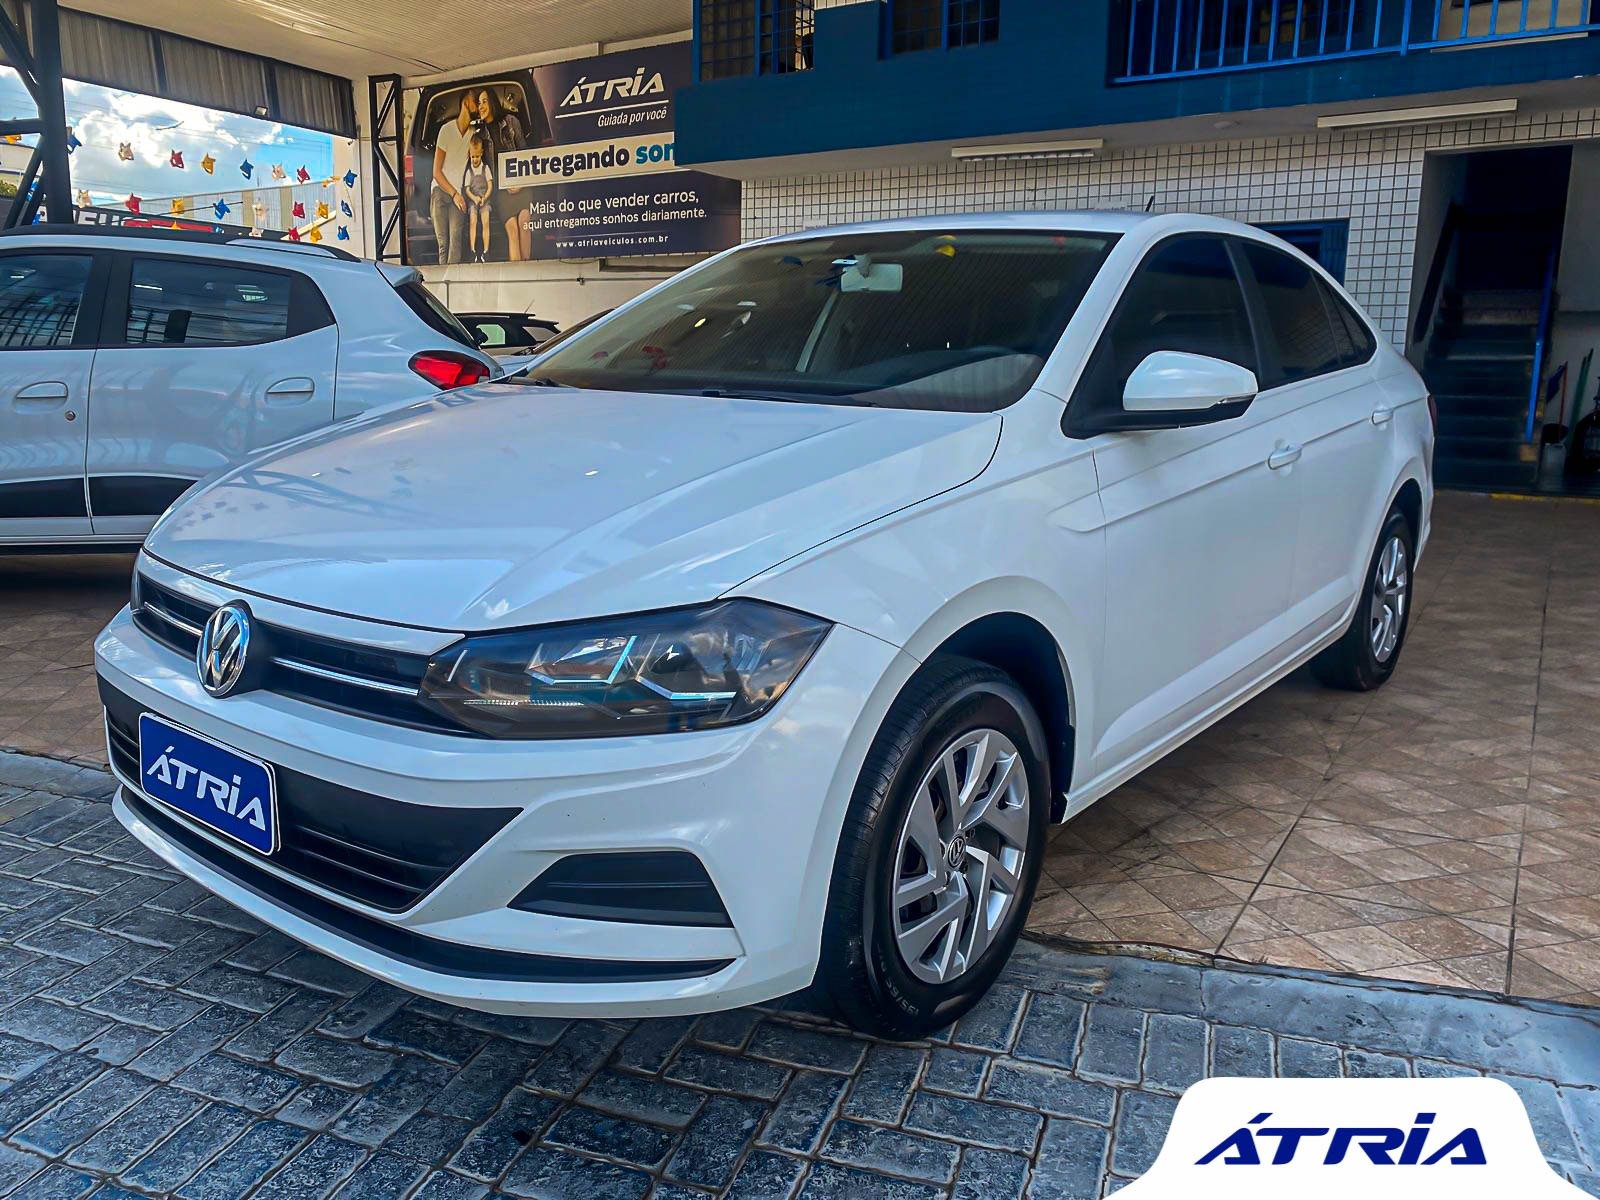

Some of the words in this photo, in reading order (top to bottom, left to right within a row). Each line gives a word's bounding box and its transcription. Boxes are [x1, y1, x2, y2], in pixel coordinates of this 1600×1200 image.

[598, 112, 628, 128] Guiada
[629, 113, 645, 126] por
[646, 106, 667, 121] você
[505, 145, 630, 177] Entregando
[529, 201, 556, 215] Mais
[558, 199, 575, 212] do
[578, 199, 602, 213] que
[605, 193, 650, 209] vender
[653, 190, 699, 206] carros,
[522, 218, 542, 231] aqui
[544, 215, 601, 229] entregamos
[602, 212, 639, 225] sonhos
[641, 207, 708, 221] diariamente.
